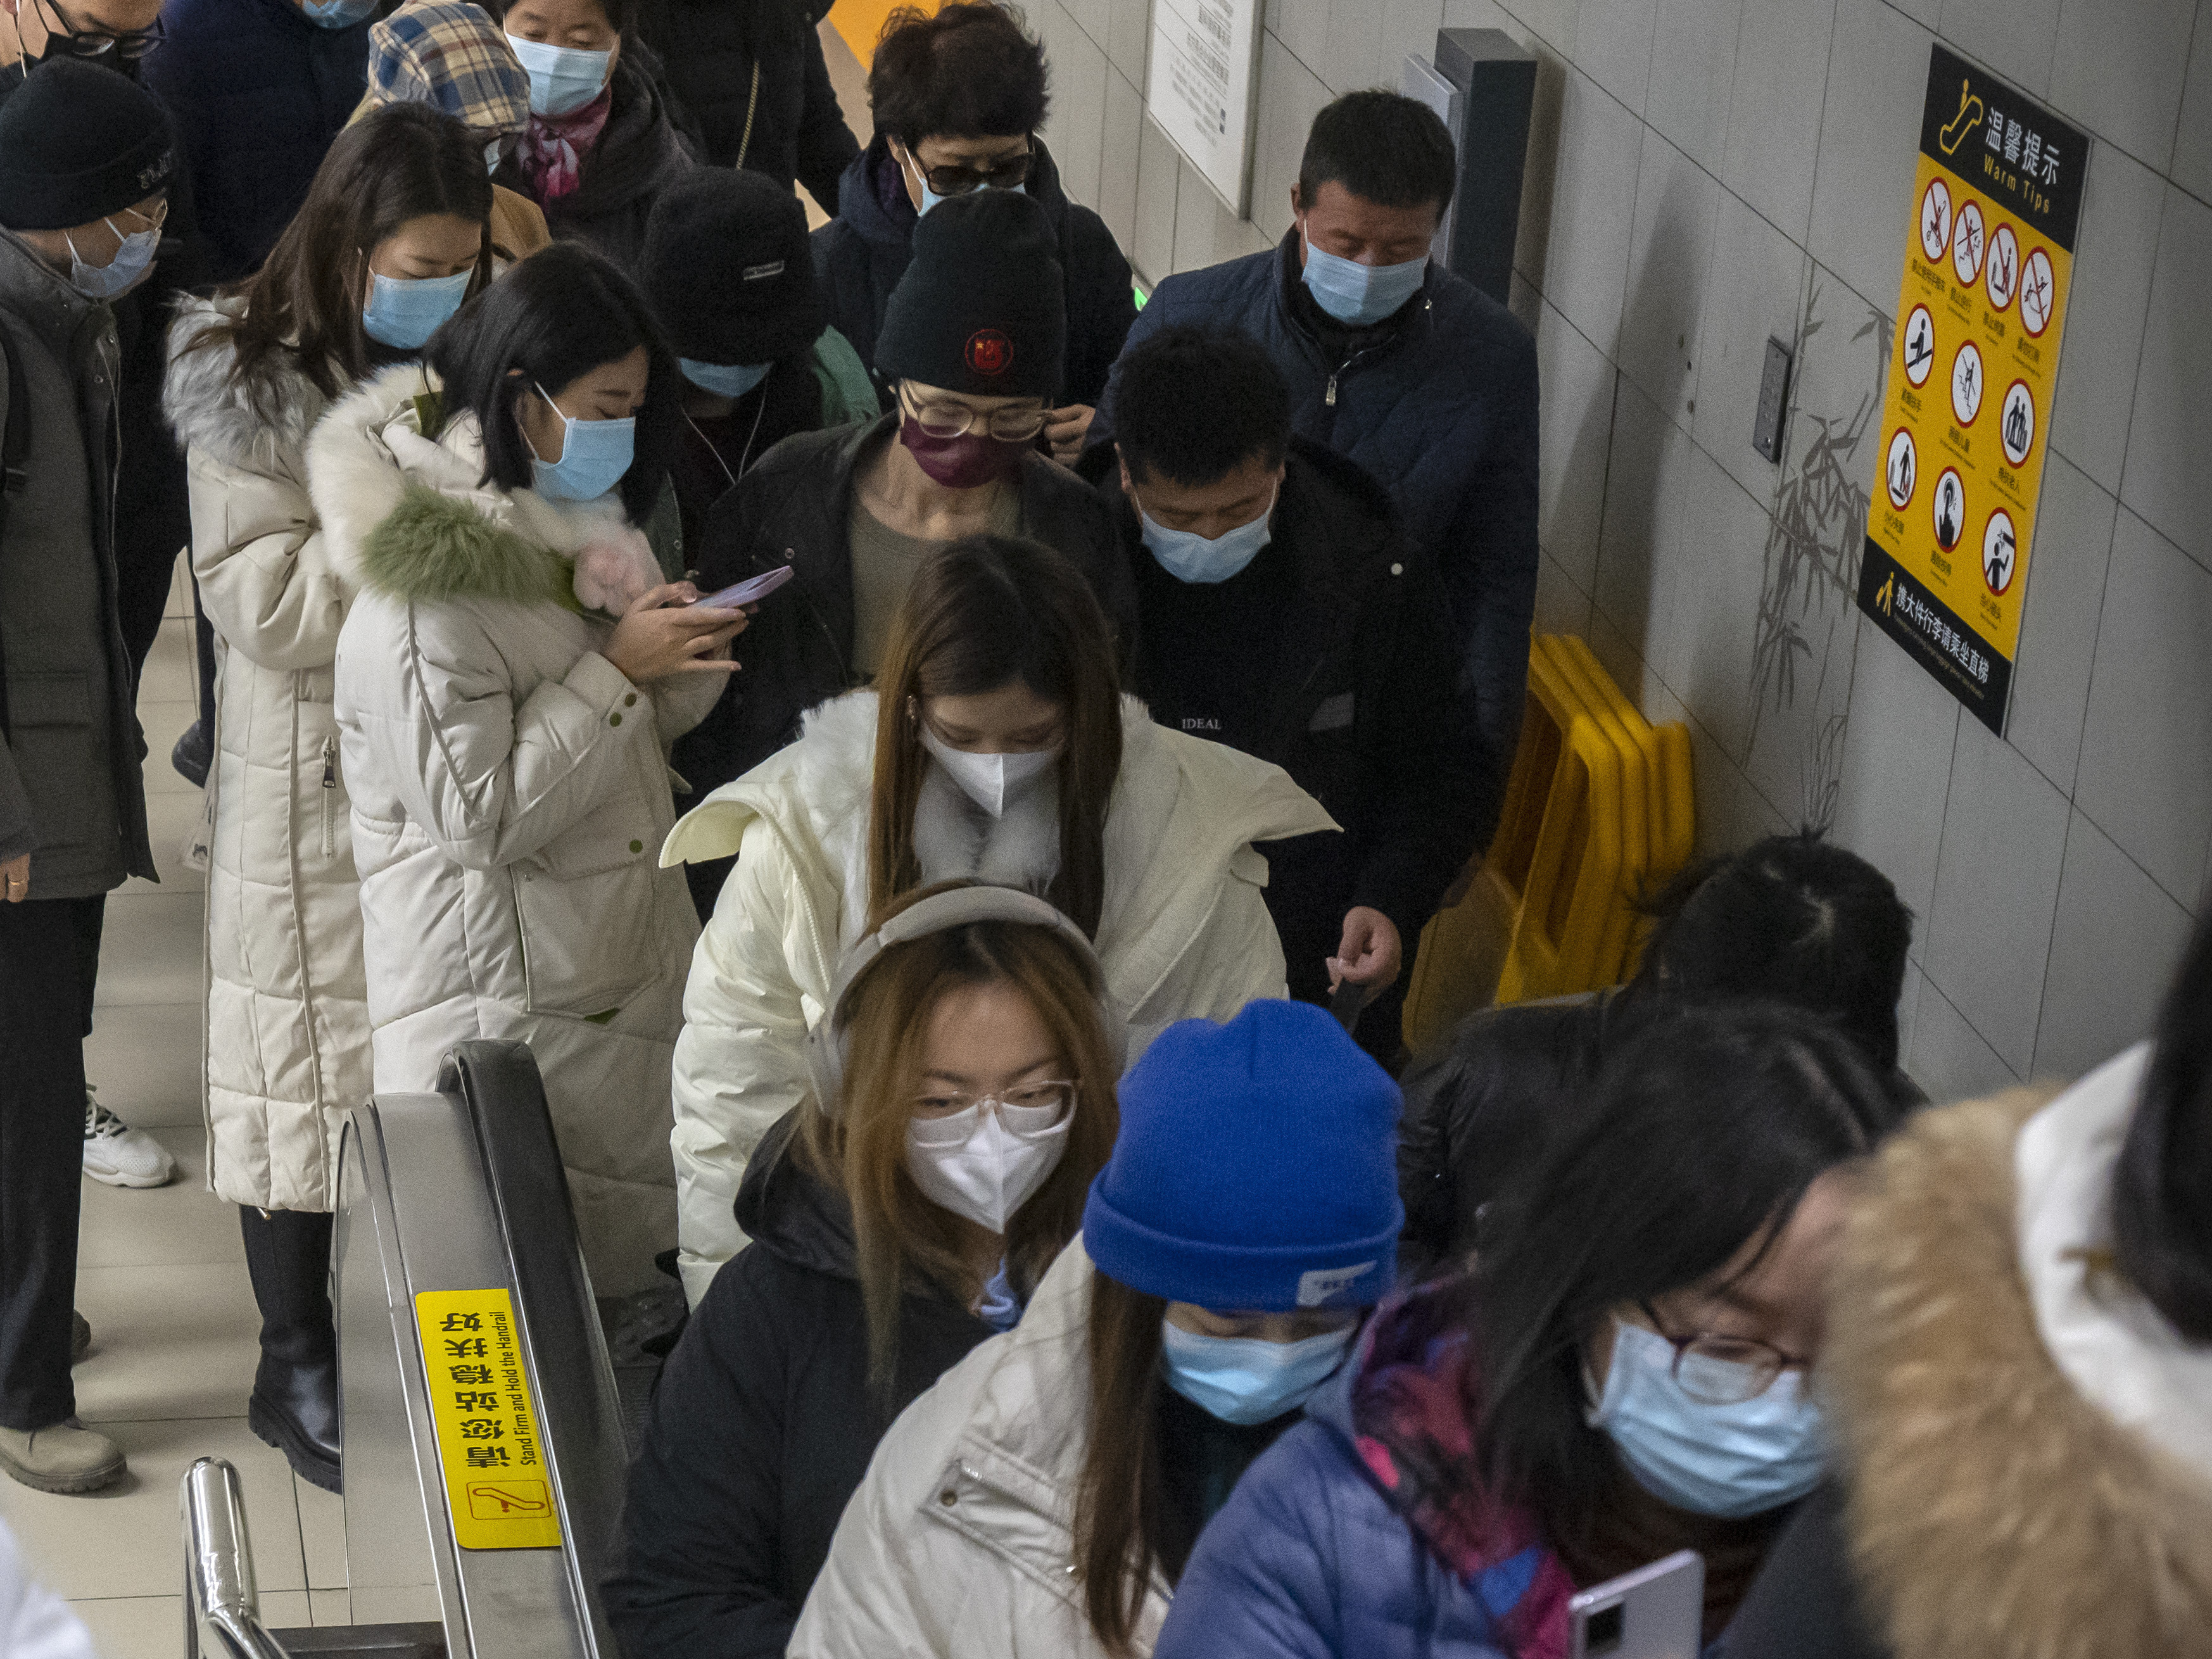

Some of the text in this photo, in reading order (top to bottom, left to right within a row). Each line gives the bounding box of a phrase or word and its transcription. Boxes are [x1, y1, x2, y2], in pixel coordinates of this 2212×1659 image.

[1984, 153, 2051, 215] Warm Tips
[1985, 106, 2060, 186] 温馨提示
[1895, 583, 1990, 684] 携大件行李请乘坐直梯
[1182, 717, 1222, 730] IDEAL
[439, 1311, 511, 1468] 请您站稳扶好
[488, 1311, 536, 1465] Stand Firm and Hold the Handrail
